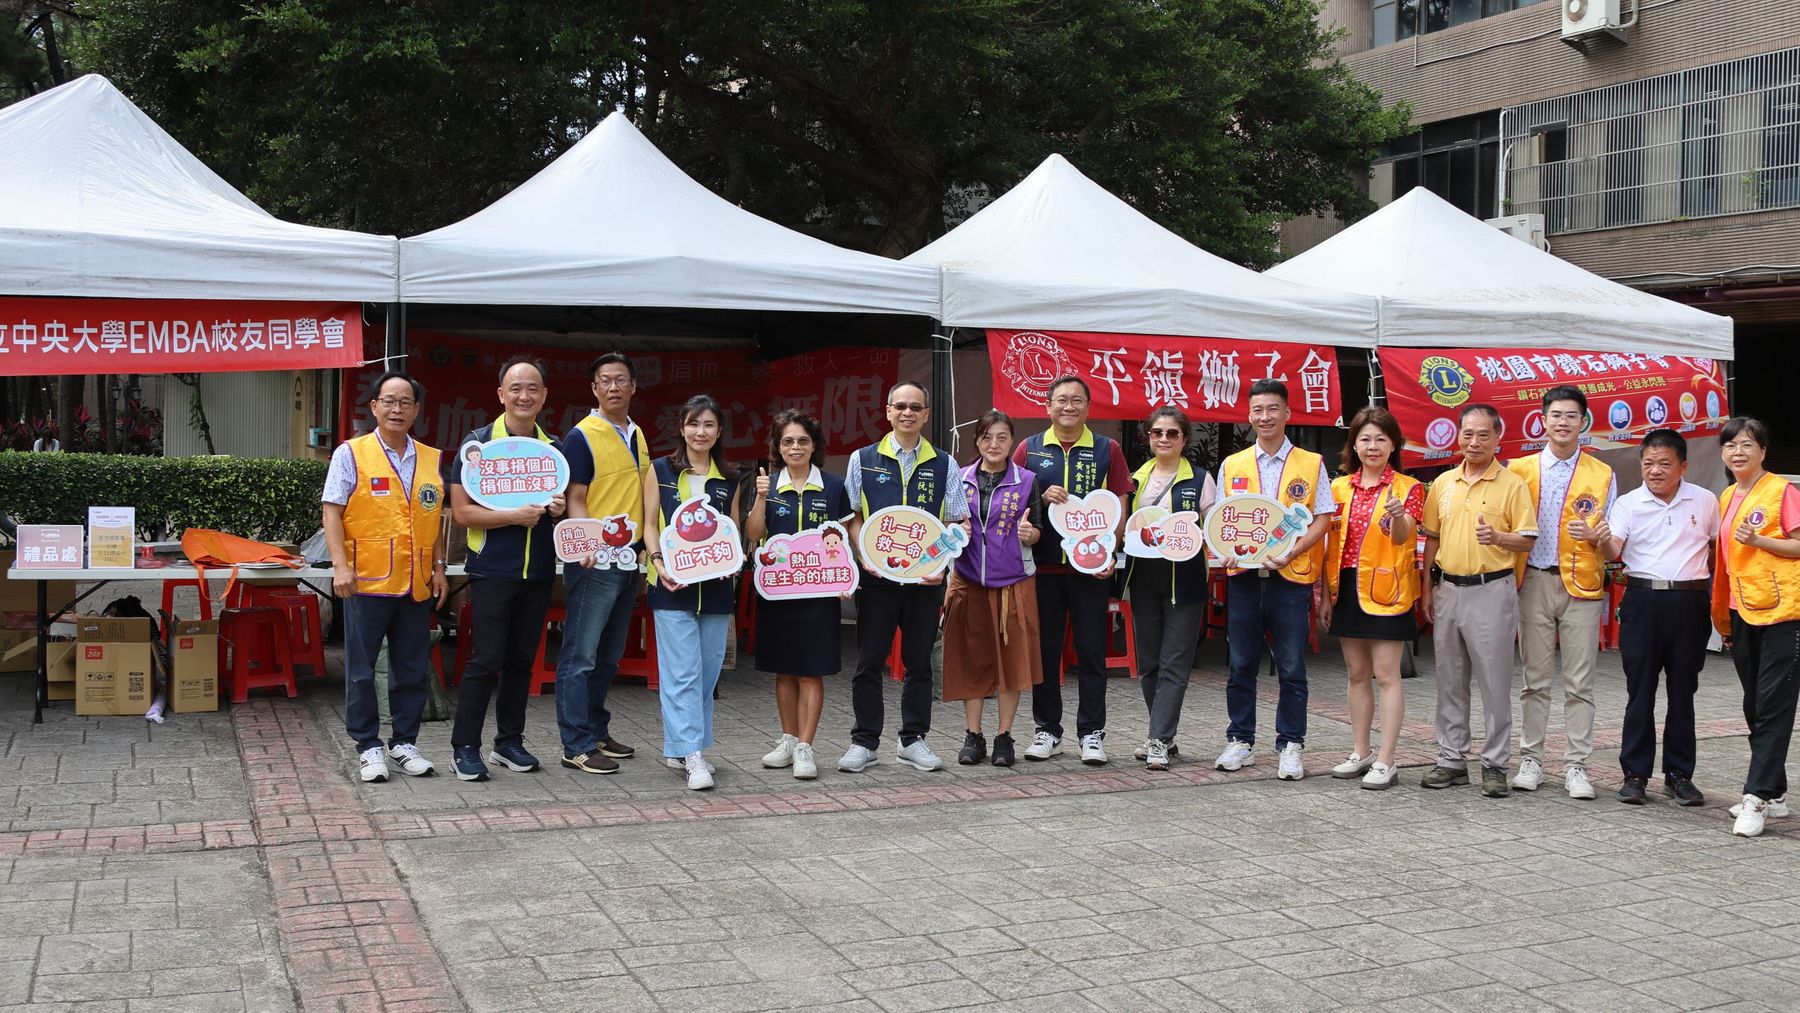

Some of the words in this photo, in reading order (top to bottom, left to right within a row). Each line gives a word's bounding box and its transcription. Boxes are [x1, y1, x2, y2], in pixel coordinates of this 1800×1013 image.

[1017, 335, 1055, 350] LIONS
[1025, 352, 1054, 380] L
[1424, 357, 1456, 368] LIONS
[1438, 370, 1458, 389] L
[480, 457, 557, 475] 沒事捐個血
[481, 475, 558, 494] 捐個血沒事
[1065, 509, 1107, 531] 缺血
[1223, 506, 1269, 525] 扎一針
[561, 527, 585, 541] 捐血
[880, 516, 927, 540] 扎一針
[1174, 520, 1188, 534] 血
[1221, 524, 1268, 544] 救一命
[563, 538, 599, 555] 我先來
[876, 534, 923, 559] 救一命
[1167, 536, 1194, 551] 不夠
[23, 546, 78, 563] 禮品處
[675, 541, 733, 571] 血不夠
[790, 551, 821, 568] 熱血
[763, 567, 851, 587] 是生命的標誌
